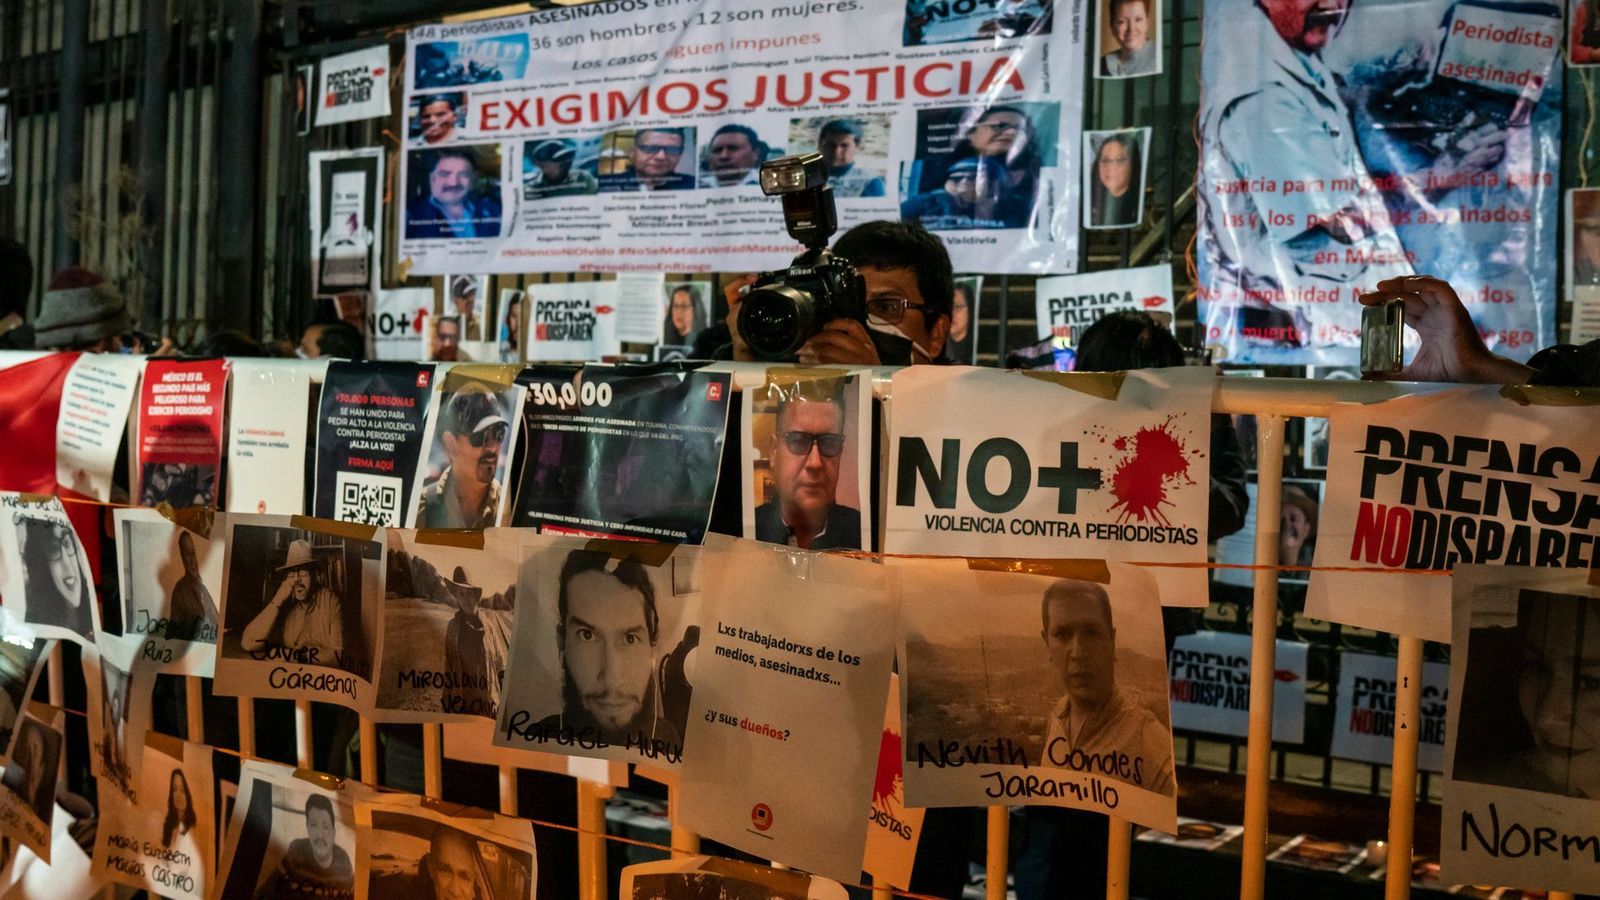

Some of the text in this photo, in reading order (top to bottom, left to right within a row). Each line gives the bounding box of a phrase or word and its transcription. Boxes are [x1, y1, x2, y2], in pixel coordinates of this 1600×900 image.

[440, 18, 525, 39] periodistas
[529, 0, 648, 26] ASESINADOS
[532, 1, 864, 51] 36 son hombres y 12 son mujeres.
[1452, 19, 1555, 50] Periodista
[572, 32, 822, 71] Los casos impunes
[479, 56, 1025, 132] EXIGIMOS JUSTICIA
[1267, 210, 1295, 226] los
[1314, 251, 1339, 265] en
[790, 267, 813, 277] Nikon
[188, 394, 206, 404] PARA
[370, 396, 415, 408] PERSONAS
[340, 407, 405, 420] SE HAN UNIDO PARA
[595, 415, 605, 423] FUE
[606, 417, 636, 426] ASESINADA
[328, 417, 416, 432] PEDIR ALTO A LA VIOLENCIA
[336, 428, 406, 442] CONTRA PERIODISTAS
[370, 442, 379, 450] LA
[348, 457, 394, 470] FIRMA AQUÍ
[895, 437, 1101, 515] NO+
[580, 517, 604, 527] JUSTICIA
[610, 522, 624, 530] CERO
[663, 528, 670, 536] SU
[924, 514, 1198, 545] VIOLENCIA CONTRA PERIODISTAS
[717, 621, 861, 666] Lxs trabajadorxs de los
[715, 645, 758, 668] medios,
[705, 709, 790, 742] ¿y sus dueños?
[1048, 737, 1143, 785] Condes
